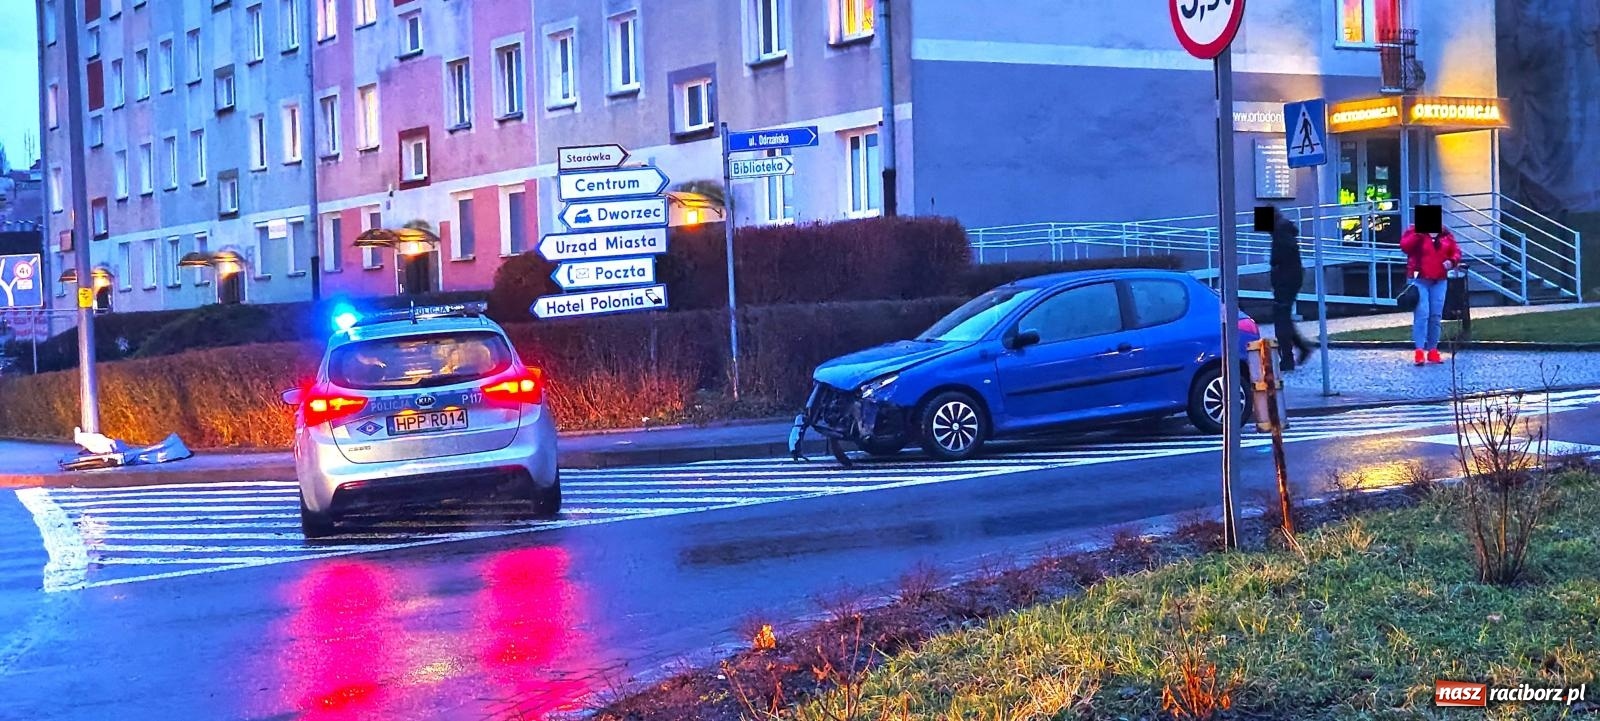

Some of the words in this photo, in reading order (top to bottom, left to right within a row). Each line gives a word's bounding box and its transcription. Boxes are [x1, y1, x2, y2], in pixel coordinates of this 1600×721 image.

[1333, 105, 1398, 123] ORTODONCJA
[1414, 103, 1500, 119] ORTODONCJA
[748, 137, 757, 146] ul.
[759, 133, 789, 146] Odrzańska
[566, 152, 611, 163] Starówka
[733, 161, 783, 175] Biblioteka
[575, 178, 640, 192] Centrum
[597, 207, 661, 221] Dworzec
[556, 238, 597, 255] Urząd
[605, 235, 657, 250] Miasta
[595, 265, 646, 280] Poczta
[546, 298, 584, 314] Hotel
[590, 293, 645, 310] Polonia
[370, 400, 412, 412] POLICJA
[419, 395, 432, 404] KIA
[461, 395, 469, 404] P
[396, 416, 426, 431] HPP
[431, 411, 466, 427] R014
